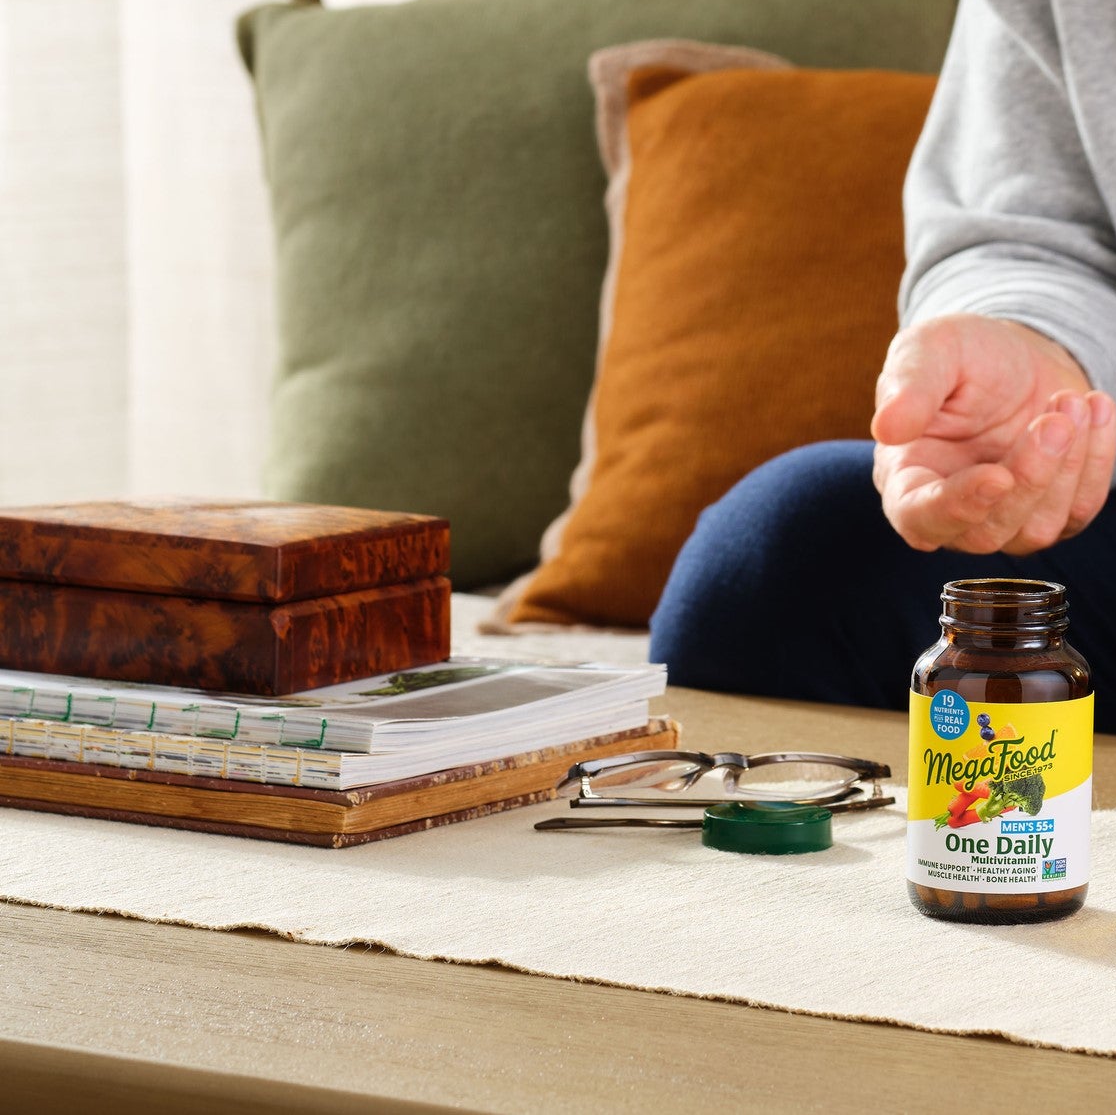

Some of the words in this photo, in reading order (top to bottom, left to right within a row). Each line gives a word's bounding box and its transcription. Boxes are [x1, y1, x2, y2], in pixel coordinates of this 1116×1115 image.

[942, 694, 955, 708] 19
[933, 706, 965, 716] NUTRIENTS
[944, 715, 965, 725] REAL
[937, 724, 961, 734] FOOD
[923, 729, 1057, 792] MegaFood
[1003, 769, 1034, 782] SINCE
[1033, 762, 1054, 775] 1973
[1002, 822, 1034, 832] MEN'S
[1035, 821, 1054, 832] 55+
[945, 833, 990, 855] One
[996, 833, 1054, 858] Daily
[971, 855, 1037, 865] Multivitamin
[917, 858, 939, 869] IMMUNE
[976, 866, 1010, 874] HEALTHY
[927, 869, 952, 880] MUSCLE
